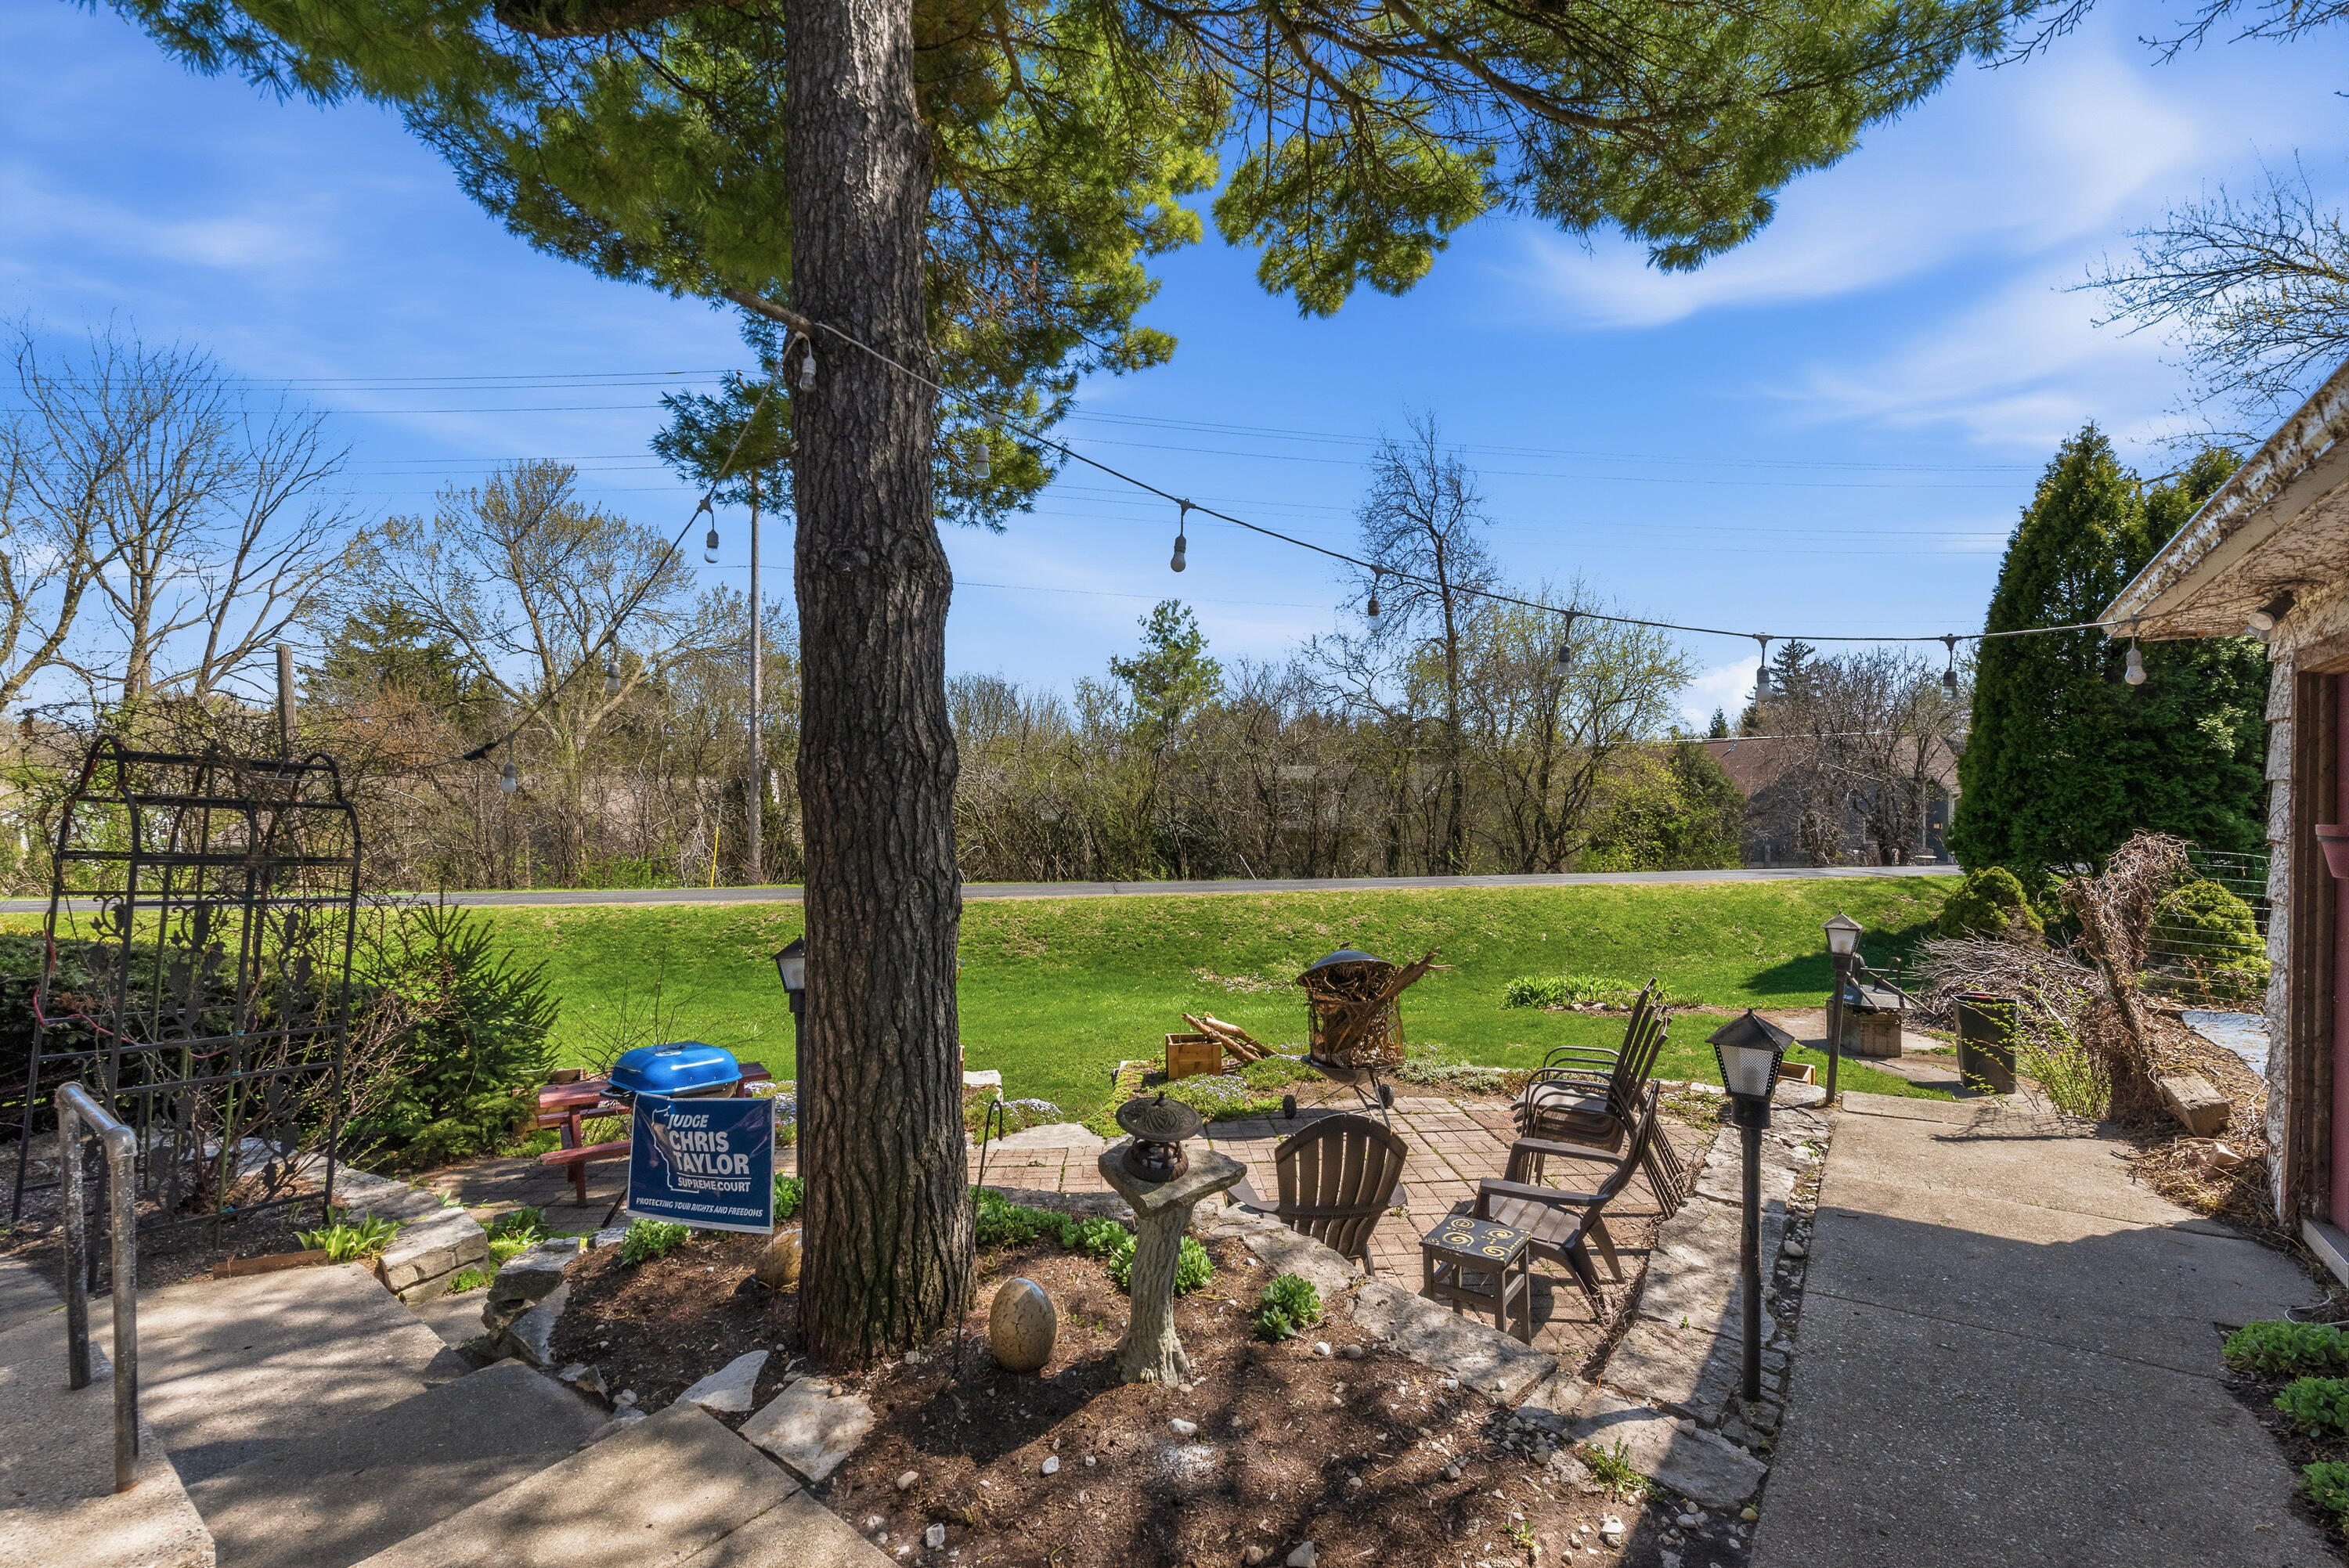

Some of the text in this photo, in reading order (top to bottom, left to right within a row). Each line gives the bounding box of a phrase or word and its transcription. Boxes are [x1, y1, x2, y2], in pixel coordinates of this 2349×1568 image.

[667, 1114, 709, 1130] JUDGE
[669, 1130, 730, 1152] CHRIS
[673, 1151, 750, 1175] TAYLOR
[677, 1177, 751, 1192] SUPREME COURT
[636, 1197, 763, 1217] PROTECTING YOUR RIGHTS AND FREEDOMS
